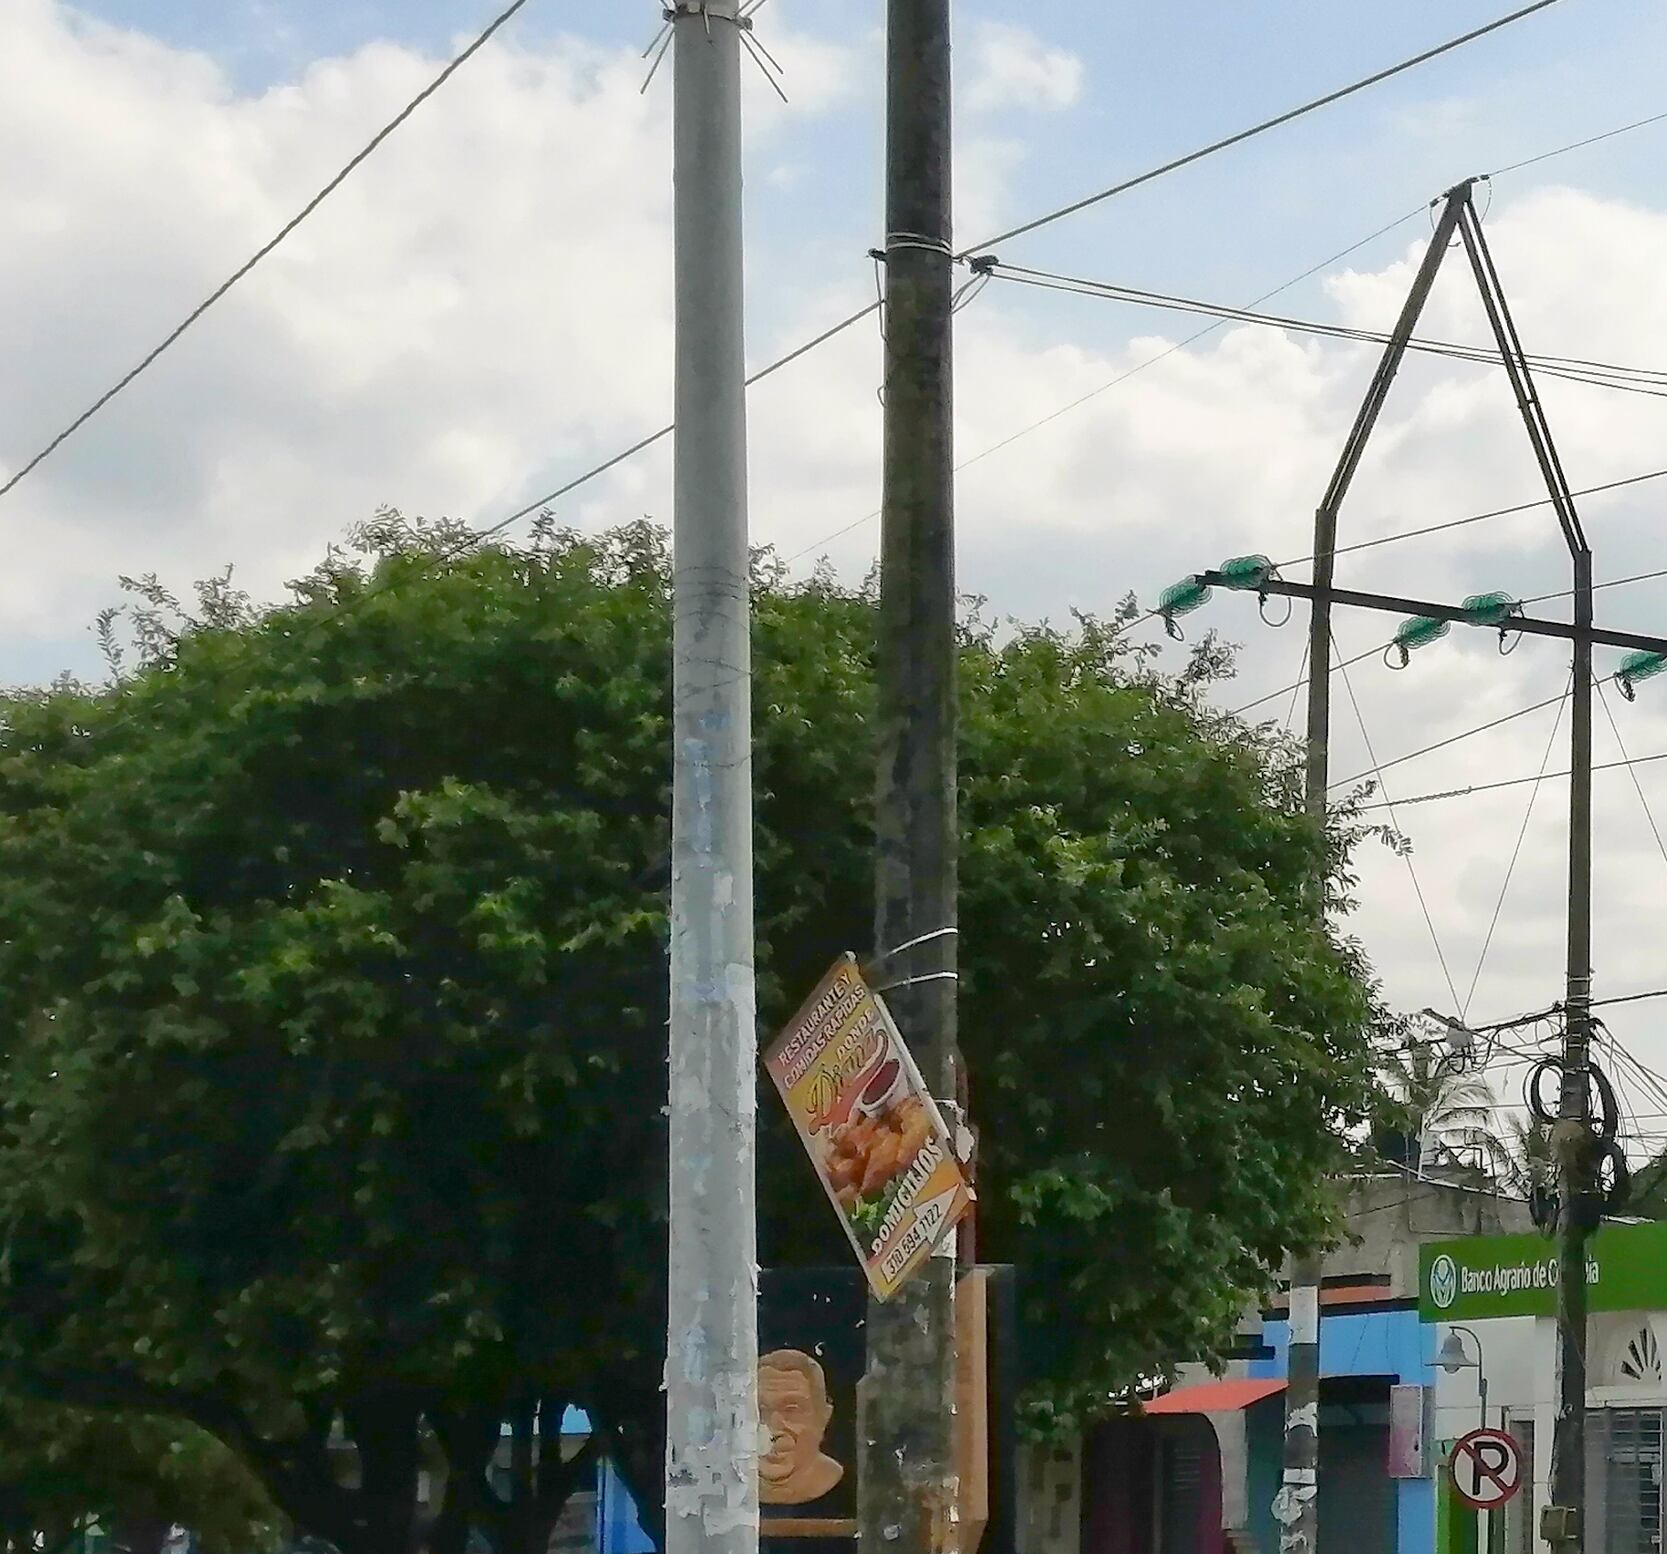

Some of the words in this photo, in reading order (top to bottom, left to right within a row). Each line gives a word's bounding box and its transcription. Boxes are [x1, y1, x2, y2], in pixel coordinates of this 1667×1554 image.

[778, 983, 846, 1067] RESTAURANTE
[837, 1008, 875, 1061] DONDE
[784, 1033, 827, 1090] COMIDAS
[871, 1135, 944, 1257] DOMICILIOS
[1461, 1266, 1493, 1293] Banco
[1493, 1260, 1531, 1296] Agrario
[1532, 1260, 1547, 1289] de
